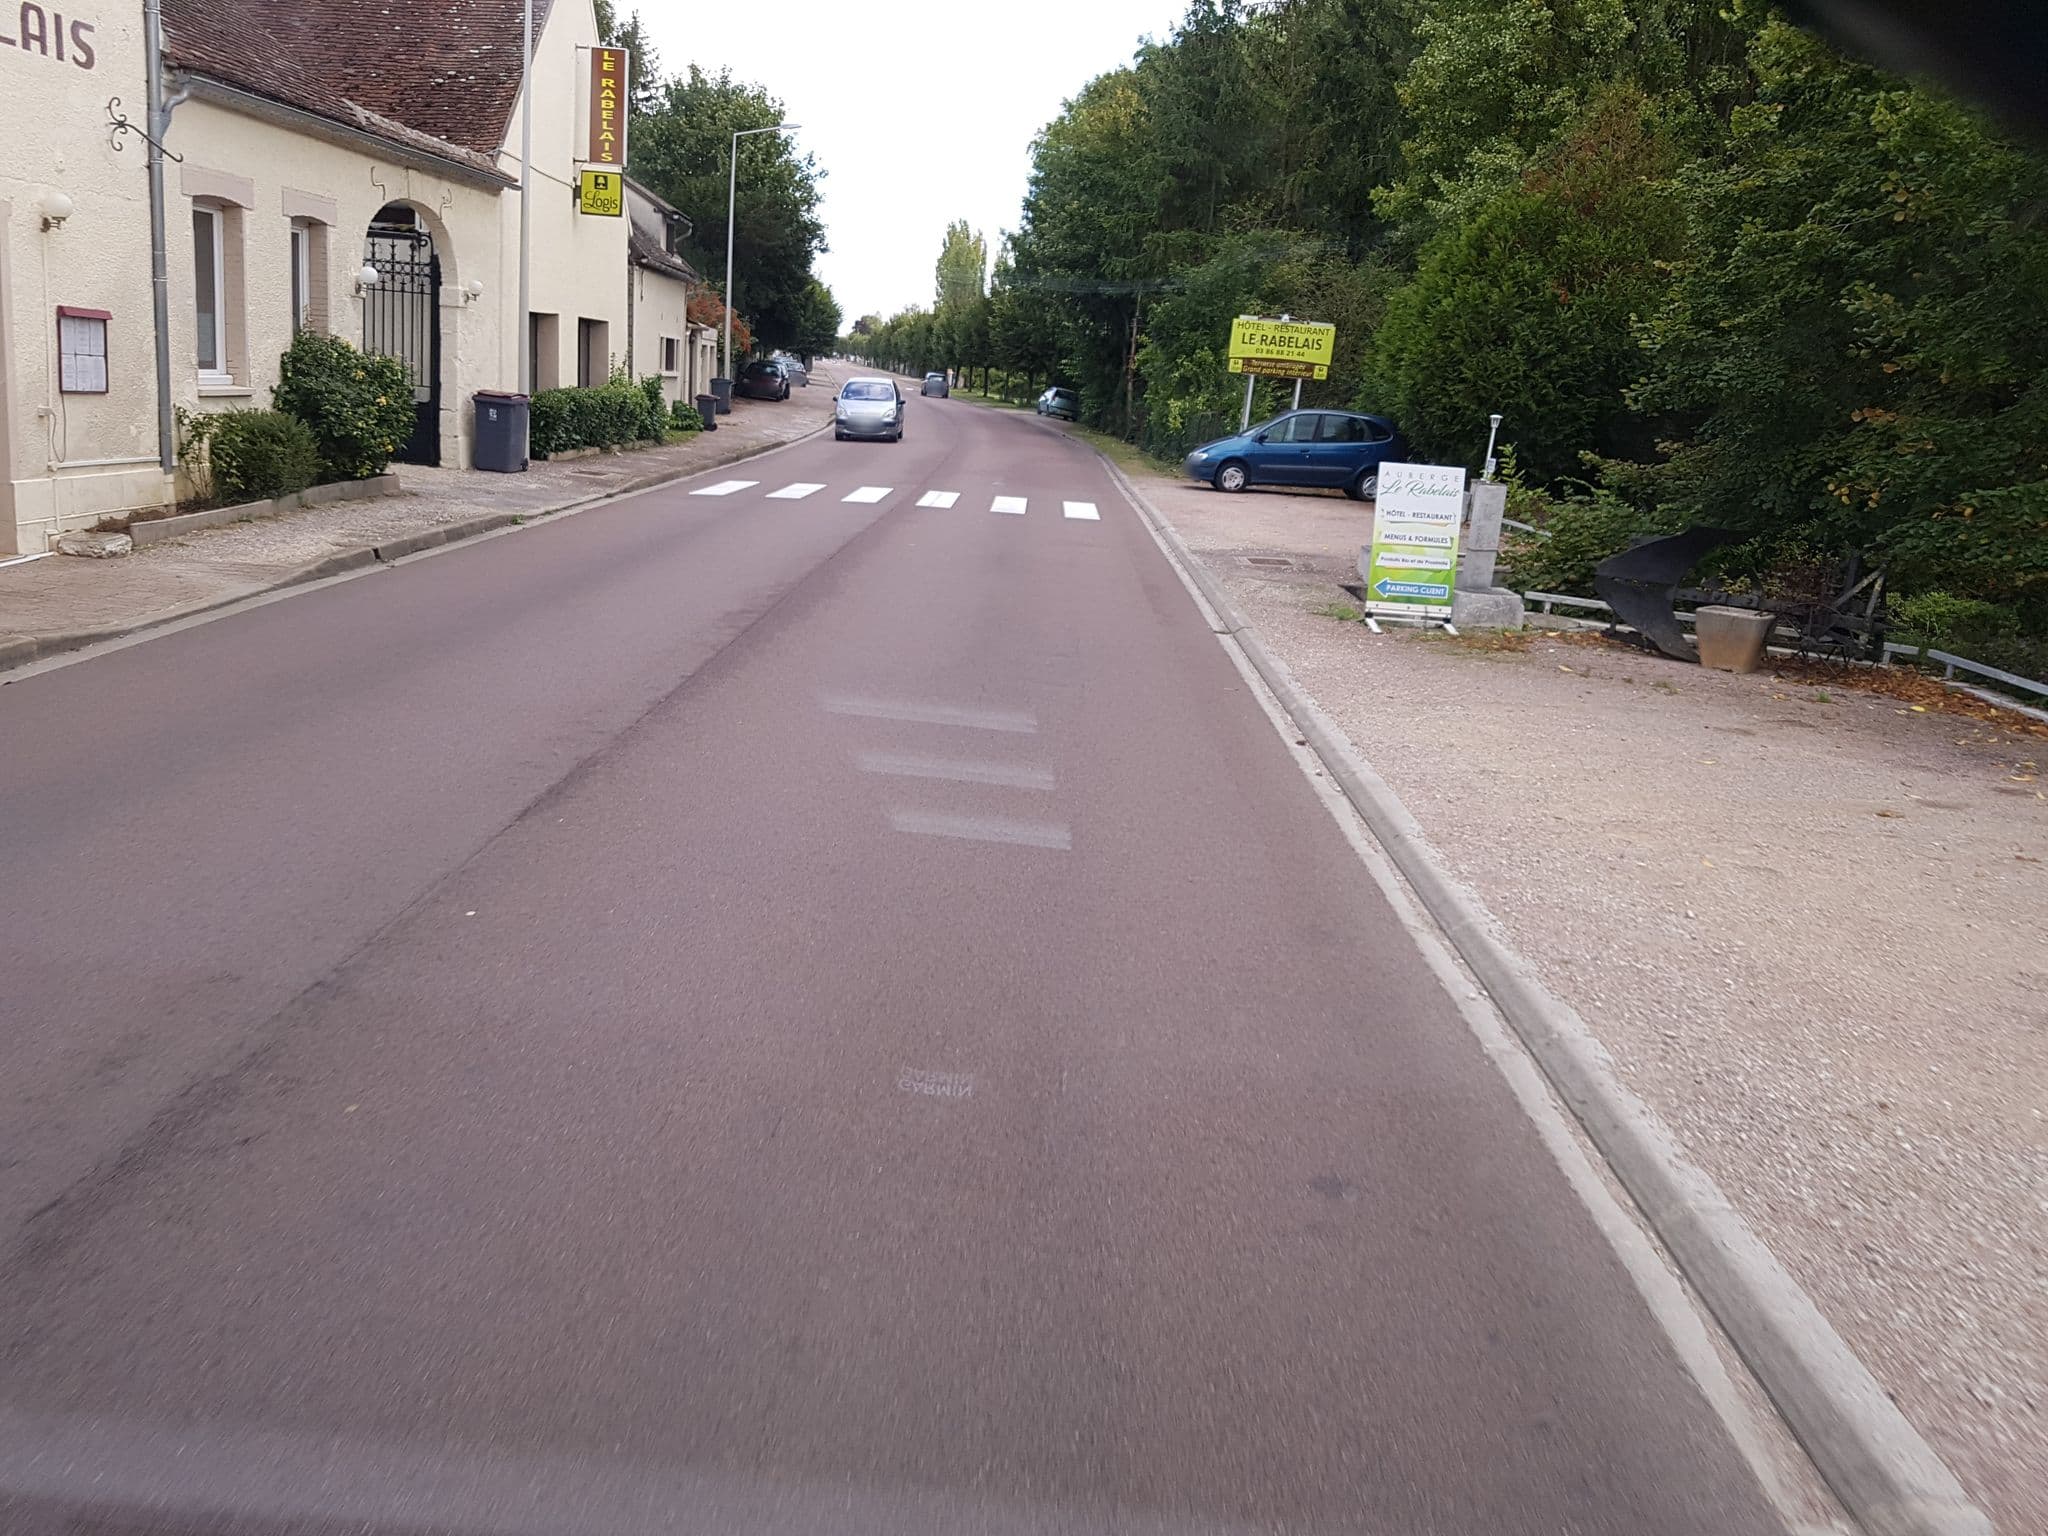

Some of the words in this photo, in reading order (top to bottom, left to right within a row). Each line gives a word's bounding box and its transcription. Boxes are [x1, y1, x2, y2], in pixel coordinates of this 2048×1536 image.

[603, 50, 615, 72] LE
[599, 78, 616, 162] RABELAIS
[583, 190, 619, 213] Logis
[1237, 320, 1266, 332] HÔTEL
[1274, 324, 1331, 337] RESTAURANT
[1241, 333, 1256, 345] LE
[1260, 334, 1323, 351] RABELAIS
[1243, 366, 1262, 374] Grand
[1262, 367, 1286, 376] parking
[1384, 472, 1462, 482] AUBERGE
[1380, 479, 1402, 496] Le
[1405, 479, 1460, 498] Rabelais
[1386, 509, 1406, 518] HÔTEL
[1412, 511, 1453, 521] RESTAURANT
[1384, 533, 1407, 542] MENUS
[1415, 535, 1449, 544] FORMULES
[1386, 584, 1419, 593] PARKING
[1420, 587, 1445, 595] CLIENT
